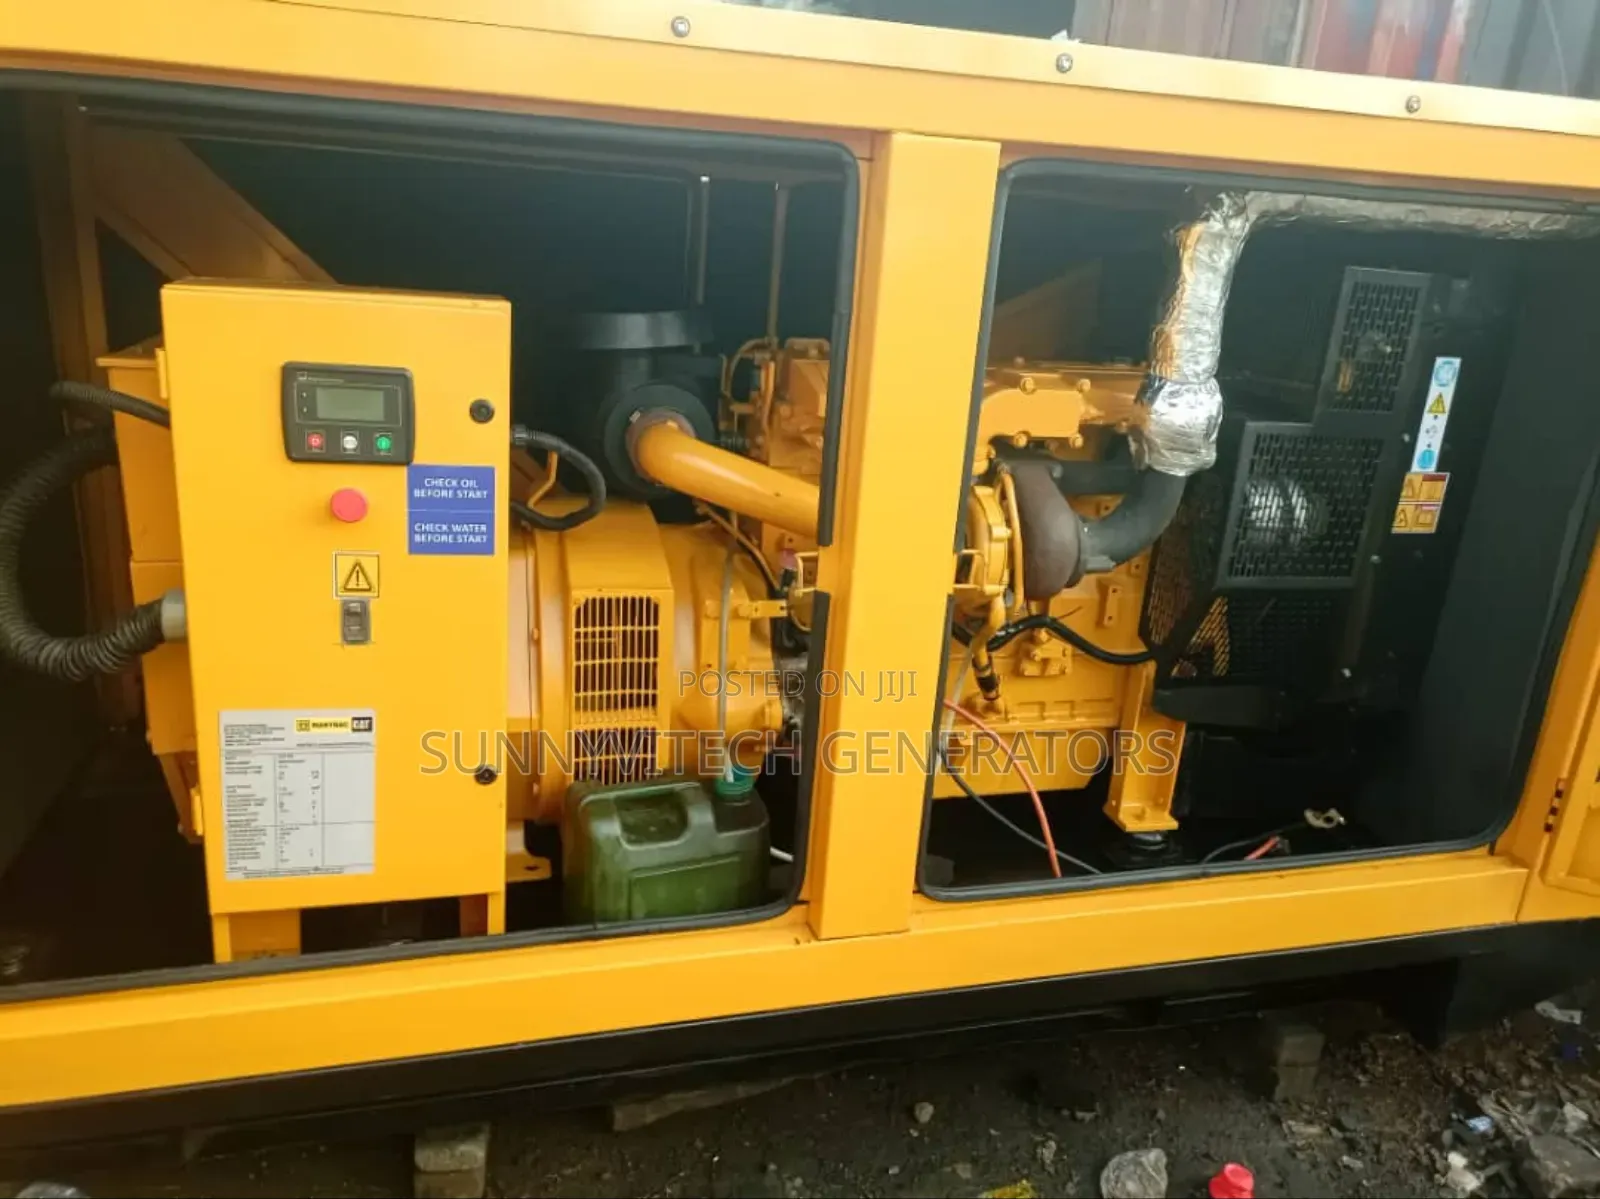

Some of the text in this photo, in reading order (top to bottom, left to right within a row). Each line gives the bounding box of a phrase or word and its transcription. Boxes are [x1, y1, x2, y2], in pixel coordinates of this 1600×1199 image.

[424, 478, 479, 488] CHECK OIL
[413, 488, 488, 499] BEFORE START
[414, 522, 487, 533] CHECK WATER
[414, 533, 488, 543] BEFORE START
